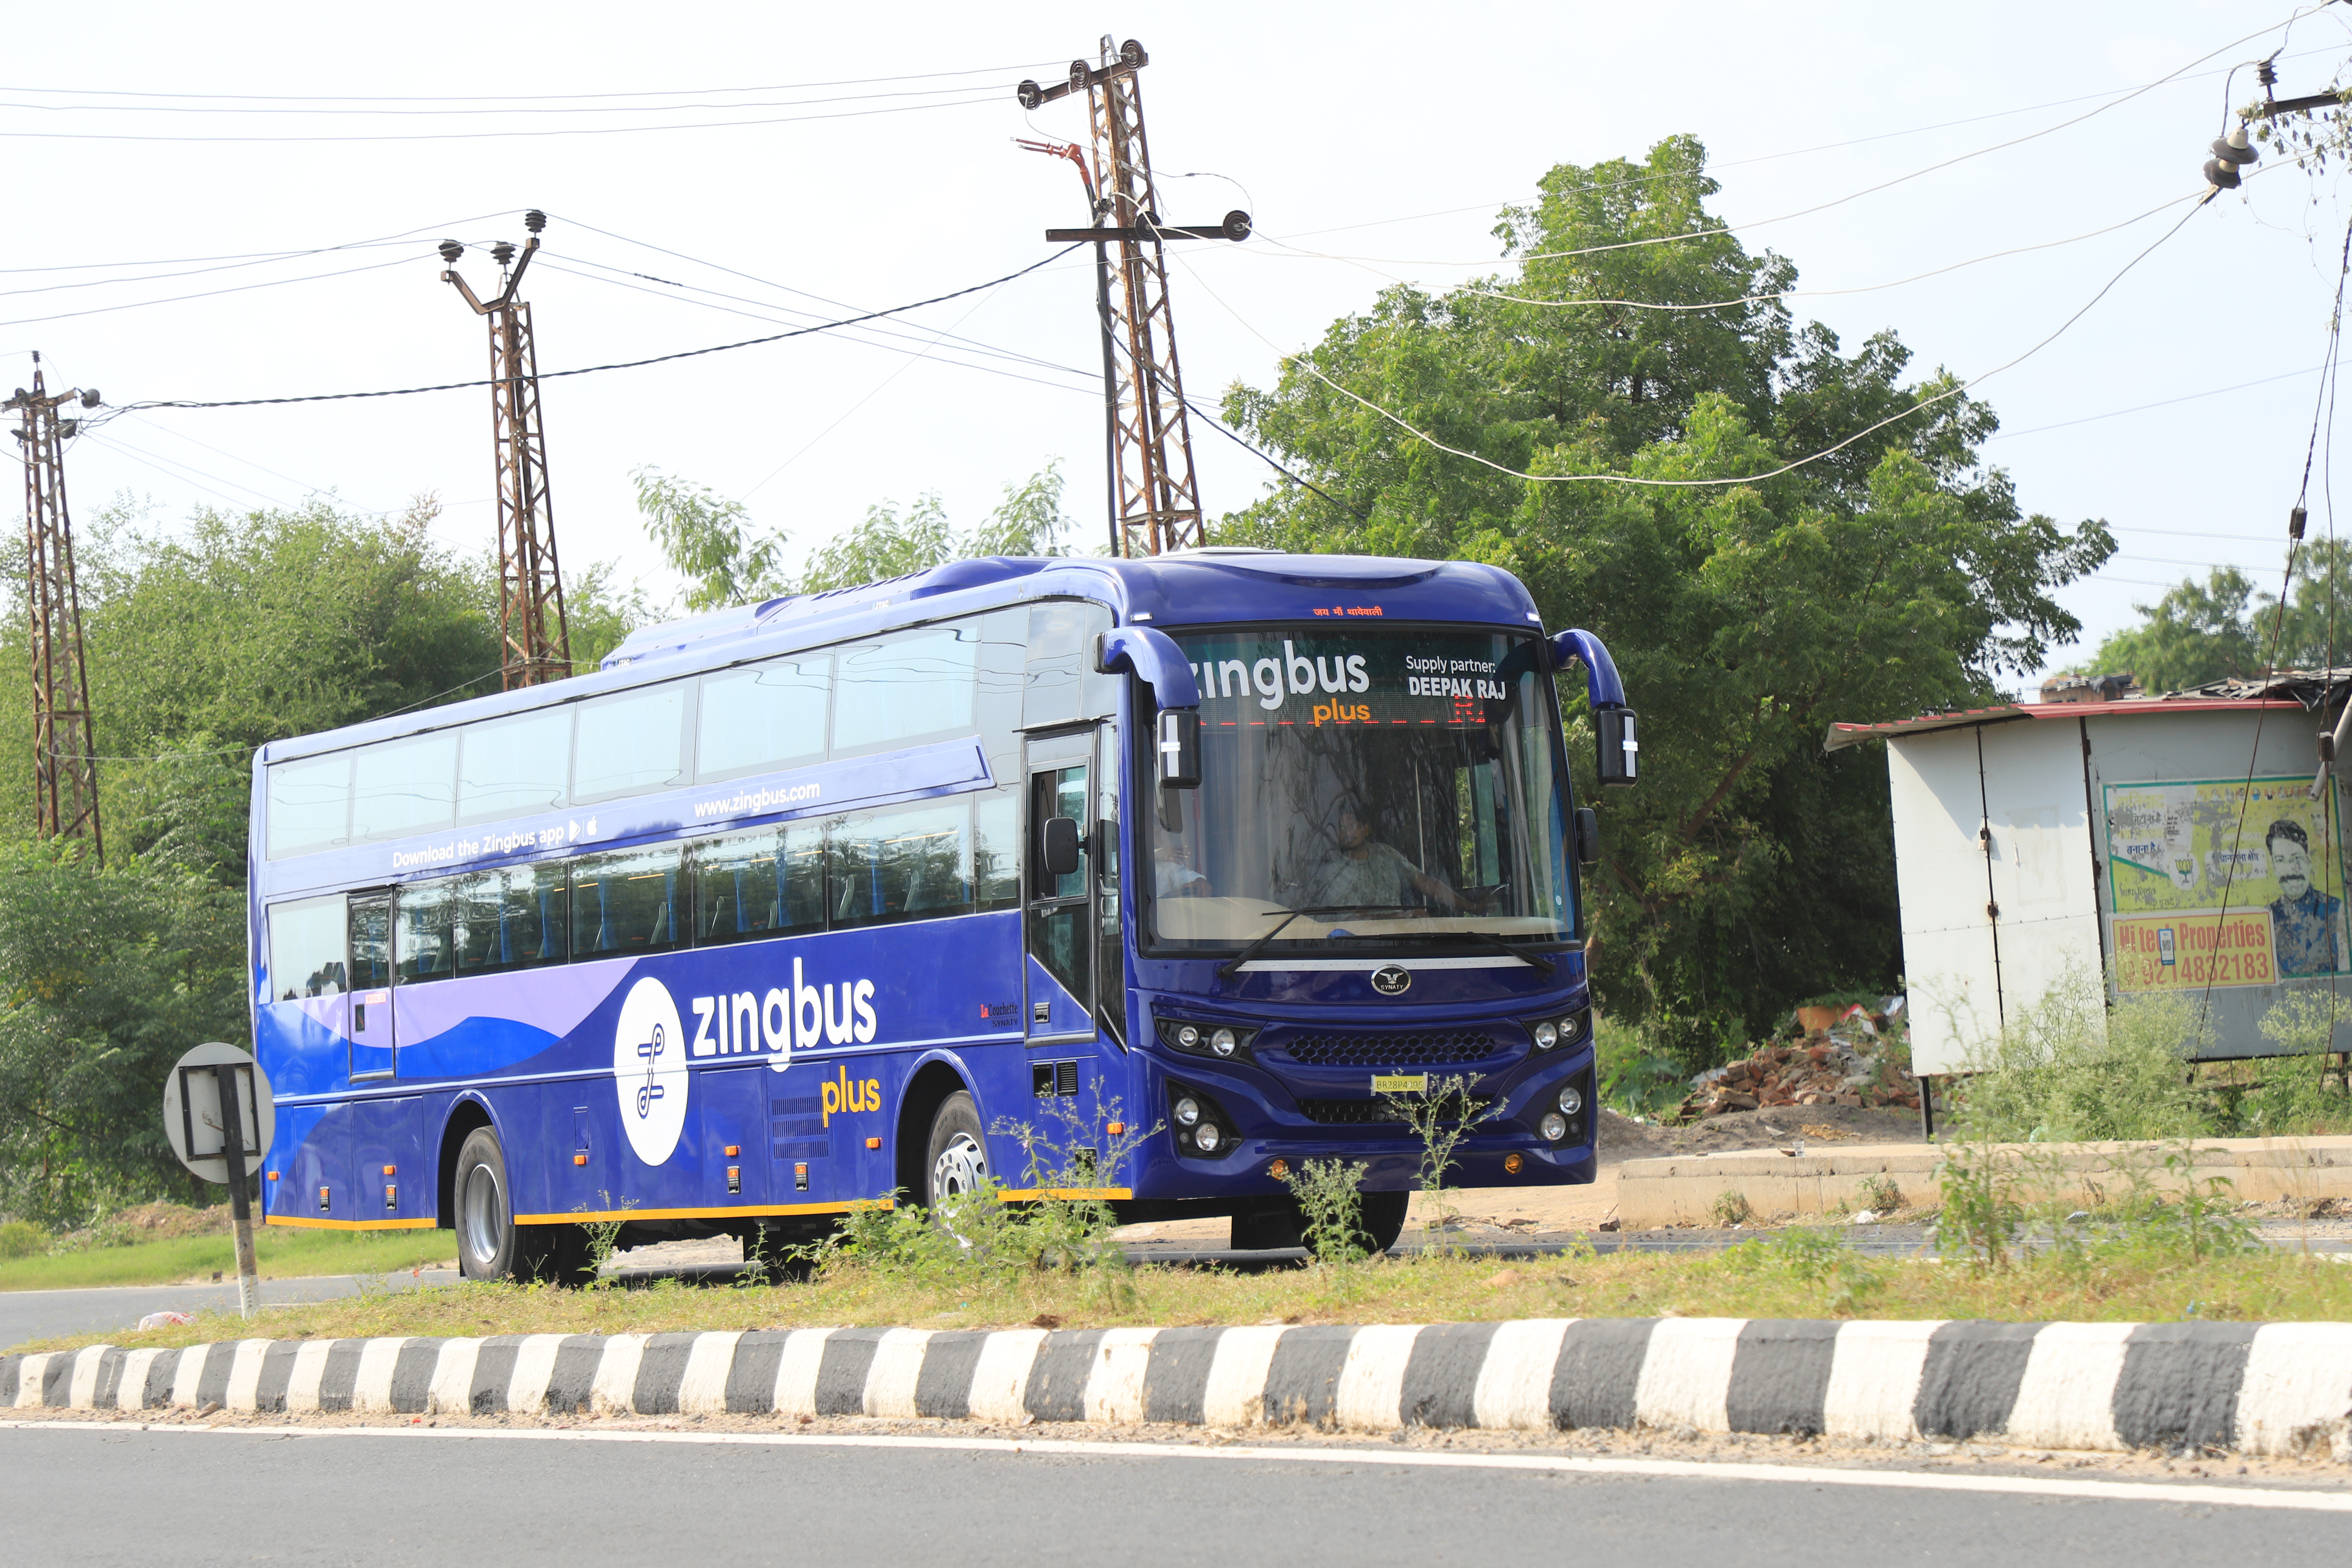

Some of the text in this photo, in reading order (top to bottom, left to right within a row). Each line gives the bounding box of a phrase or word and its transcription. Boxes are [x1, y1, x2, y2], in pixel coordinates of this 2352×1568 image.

[874, 600, 889, 609] JTAC
[1332, 606, 1343, 616] माँ
[1347, 606, 1383, 616] थावेवाली
[617, 658, 630, 668] JTAC
[1406, 655, 1496, 674] Supply partner:
[1409, 677, 1506, 700] DEEPAK RAJ
[1314, 698, 1370, 727] plus
[695, 783, 820, 818] www.zingbus.com
[393, 827, 564, 868] Download the Zingbus app
[2119, 926, 2136, 954] Hi
[2179, 920, 2265, 952] Properties
[2141, 952, 2268, 985] 9214832183
[693, 957, 877, 1072] zingbus
[993, 1019, 1018, 1027] SYNATY
[822, 1065, 881, 1128] plus
